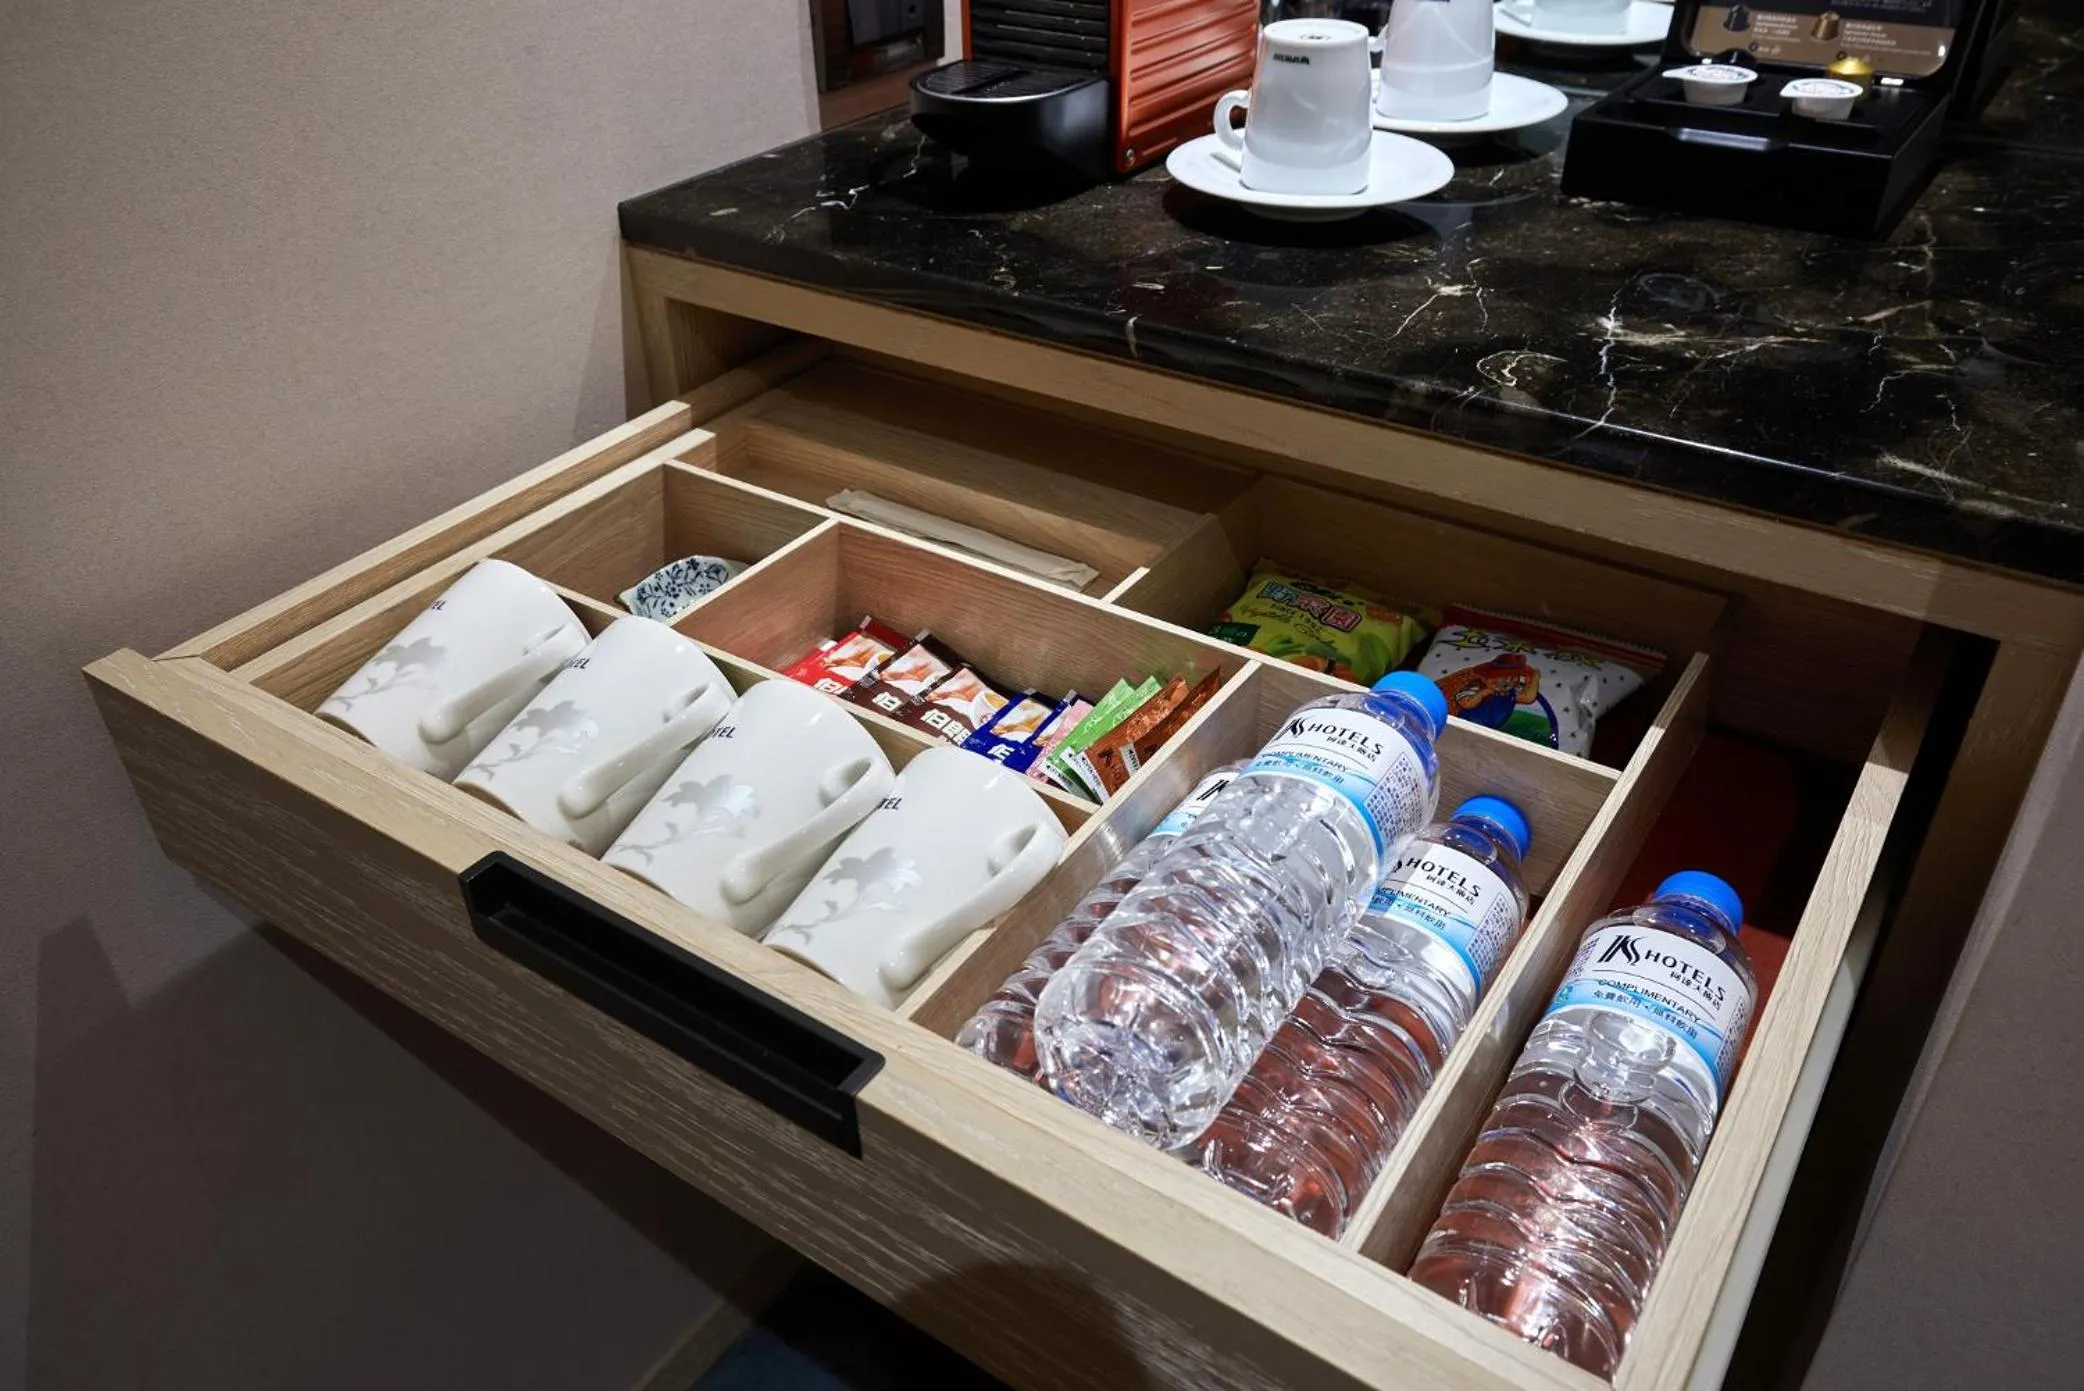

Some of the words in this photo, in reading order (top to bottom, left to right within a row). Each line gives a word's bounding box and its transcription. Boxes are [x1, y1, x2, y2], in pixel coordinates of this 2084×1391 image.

[1307, 722, 1386, 756] HOTELS
[1405, 857, 1482, 898] HOTELS
[1644, 949, 1727, 1002] HOTELS
[1598, 978, 1702, 1024] COMPLIMENTARY
